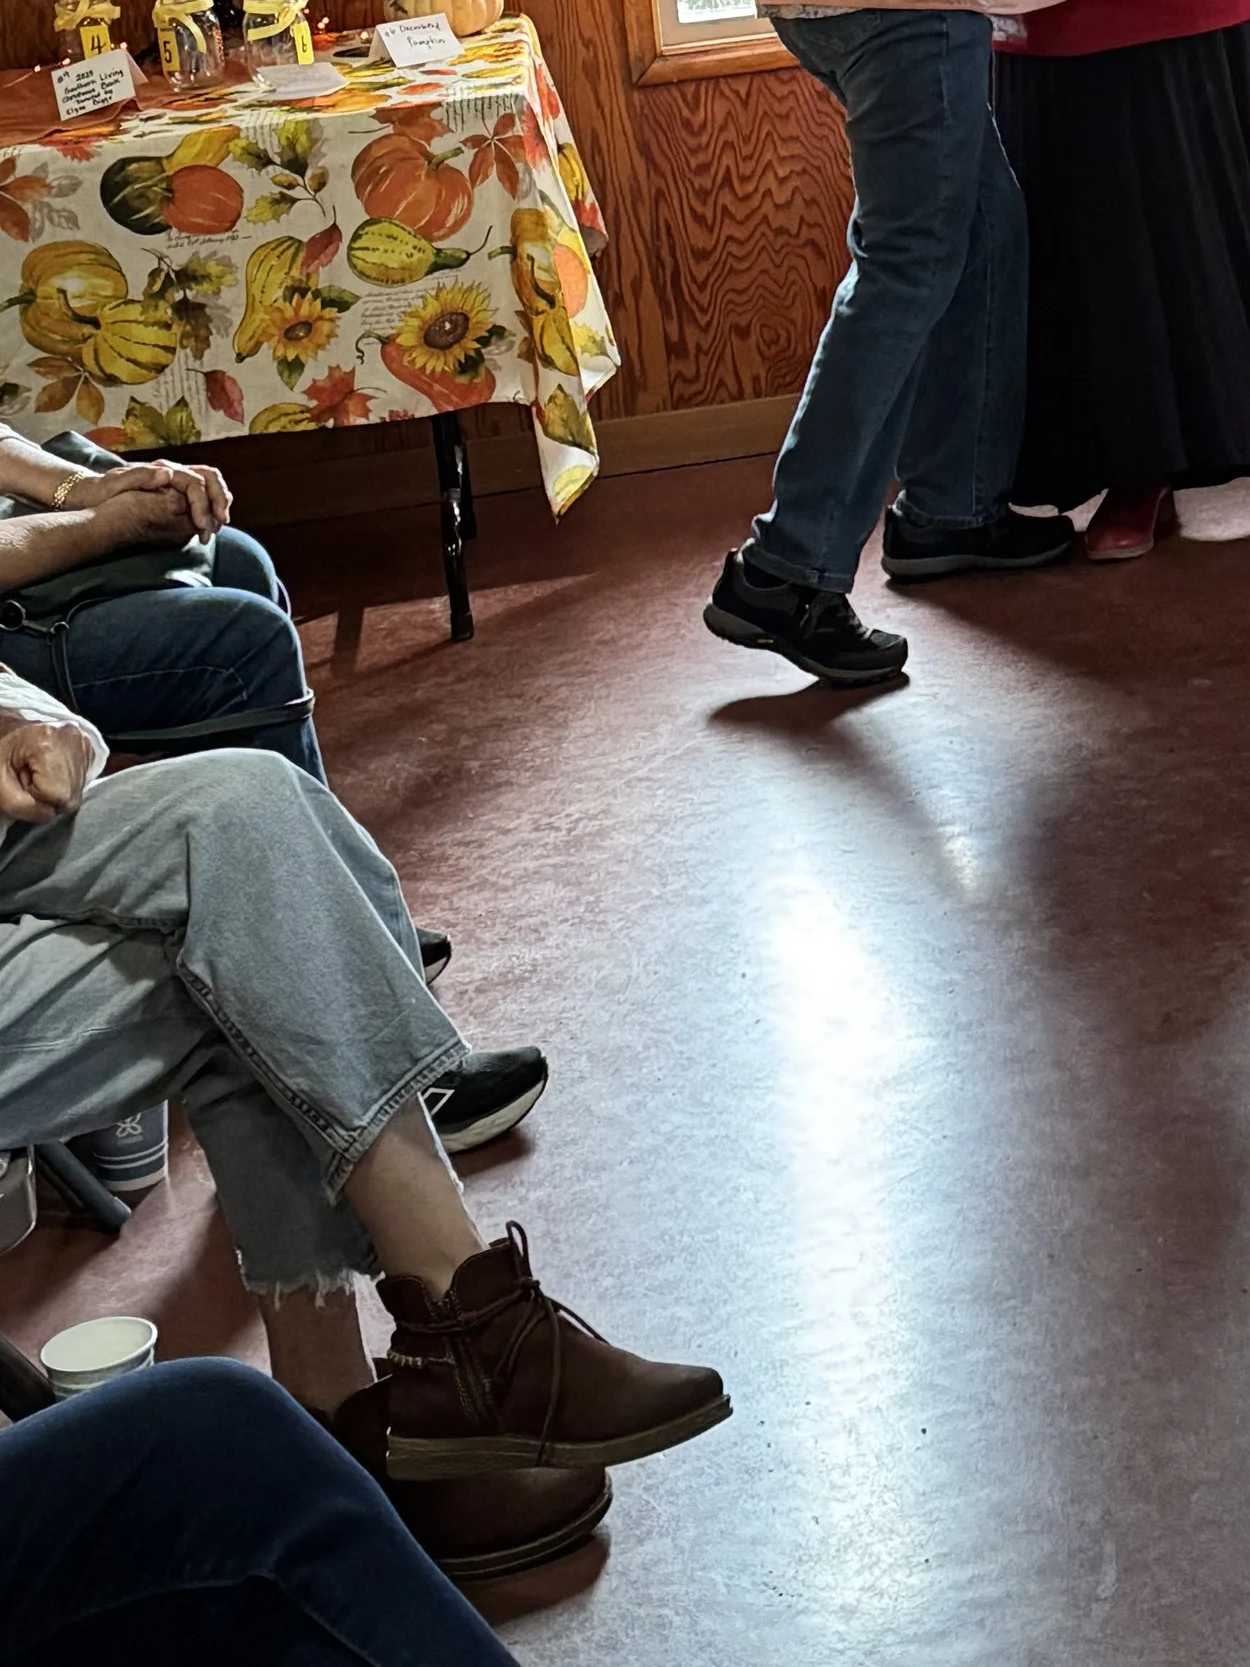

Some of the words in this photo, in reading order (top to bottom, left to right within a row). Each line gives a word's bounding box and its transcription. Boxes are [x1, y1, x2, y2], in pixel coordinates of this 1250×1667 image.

[91, 34, 107, 54] 4
[163, 40, 173, 64] 5
[301, 35, 309, 53] 6
[100, 69, 124, 81] Living
